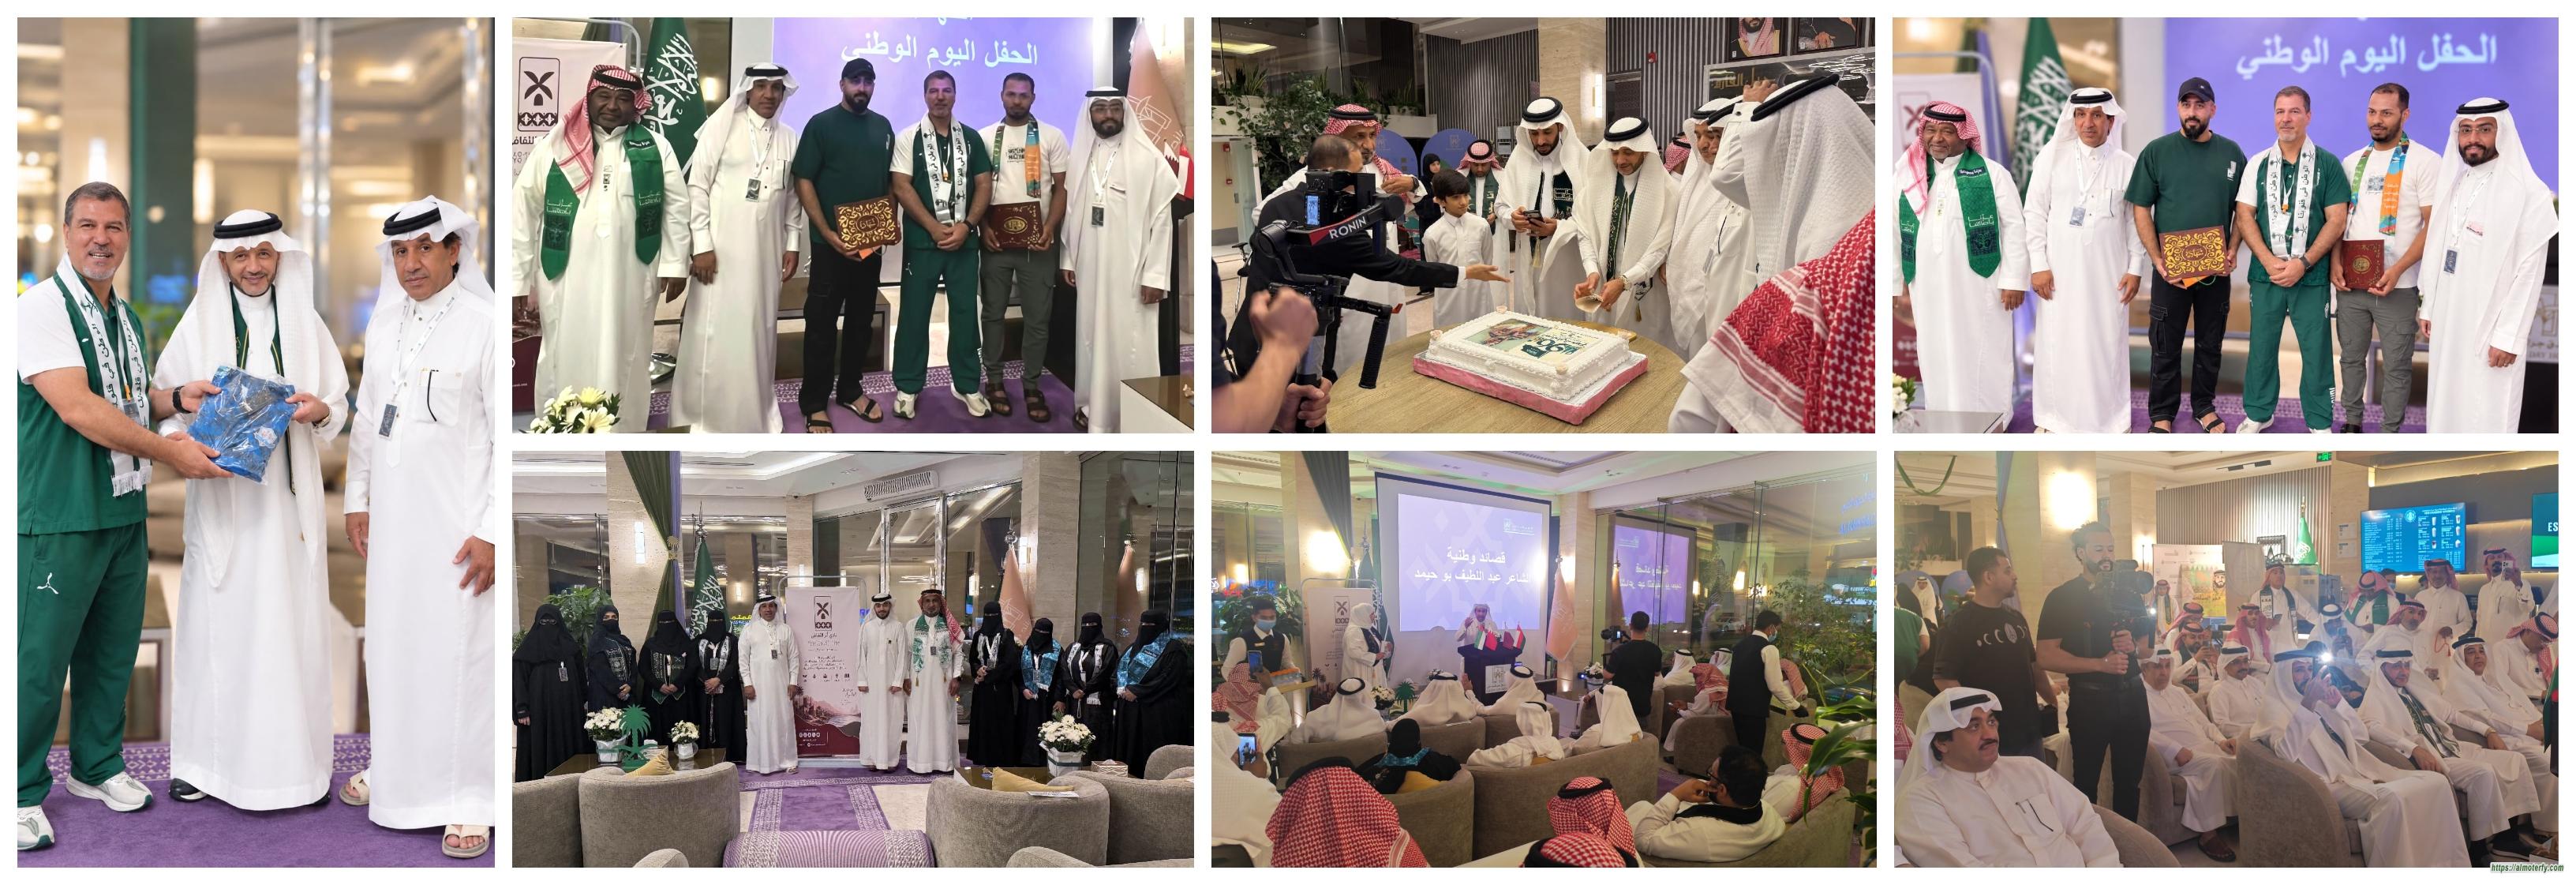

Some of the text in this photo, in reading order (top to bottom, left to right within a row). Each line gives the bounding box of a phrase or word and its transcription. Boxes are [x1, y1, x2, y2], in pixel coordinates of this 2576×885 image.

[927, 37, 975, 69] اليوم
[984, 40, 1038, 68] الحفل
[2236, 32, 2497, 80] الحفل اليوم الوطني
[1328, 216, 1367, 239] RONIN
[1447, 546, 1507, 564] قصائد وطنية
[1443, 573, 1452, 582] بو
[1455, 569, 1485, 583] اللطيف
[1488, 572, 1501, 584] عبد
